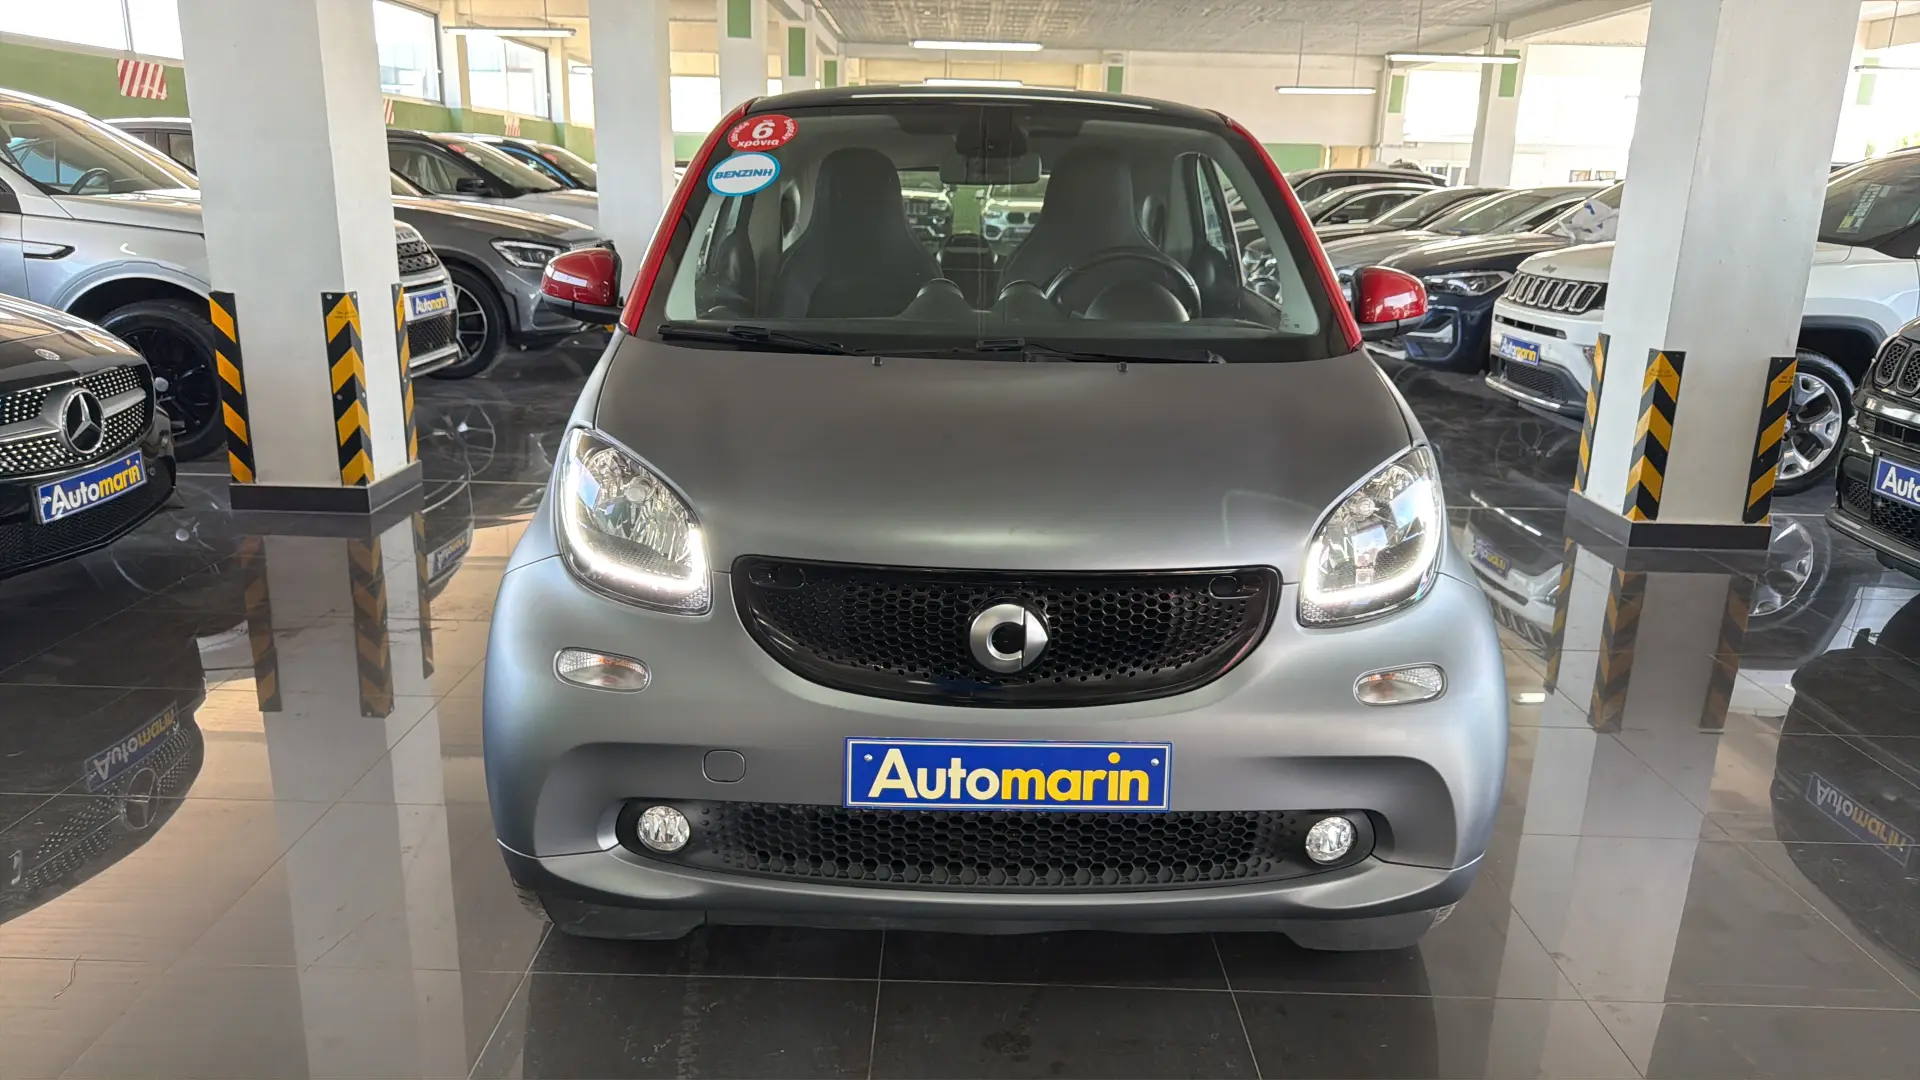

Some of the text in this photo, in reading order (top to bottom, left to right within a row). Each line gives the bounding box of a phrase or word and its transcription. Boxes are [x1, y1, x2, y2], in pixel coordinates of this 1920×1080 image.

[737, 139, 779, 148] χρόνια
[752, 122, 775, 139] 6
[51, 459, 141, 515] Automarin
[867, 748, 1149, 801] Automarin
